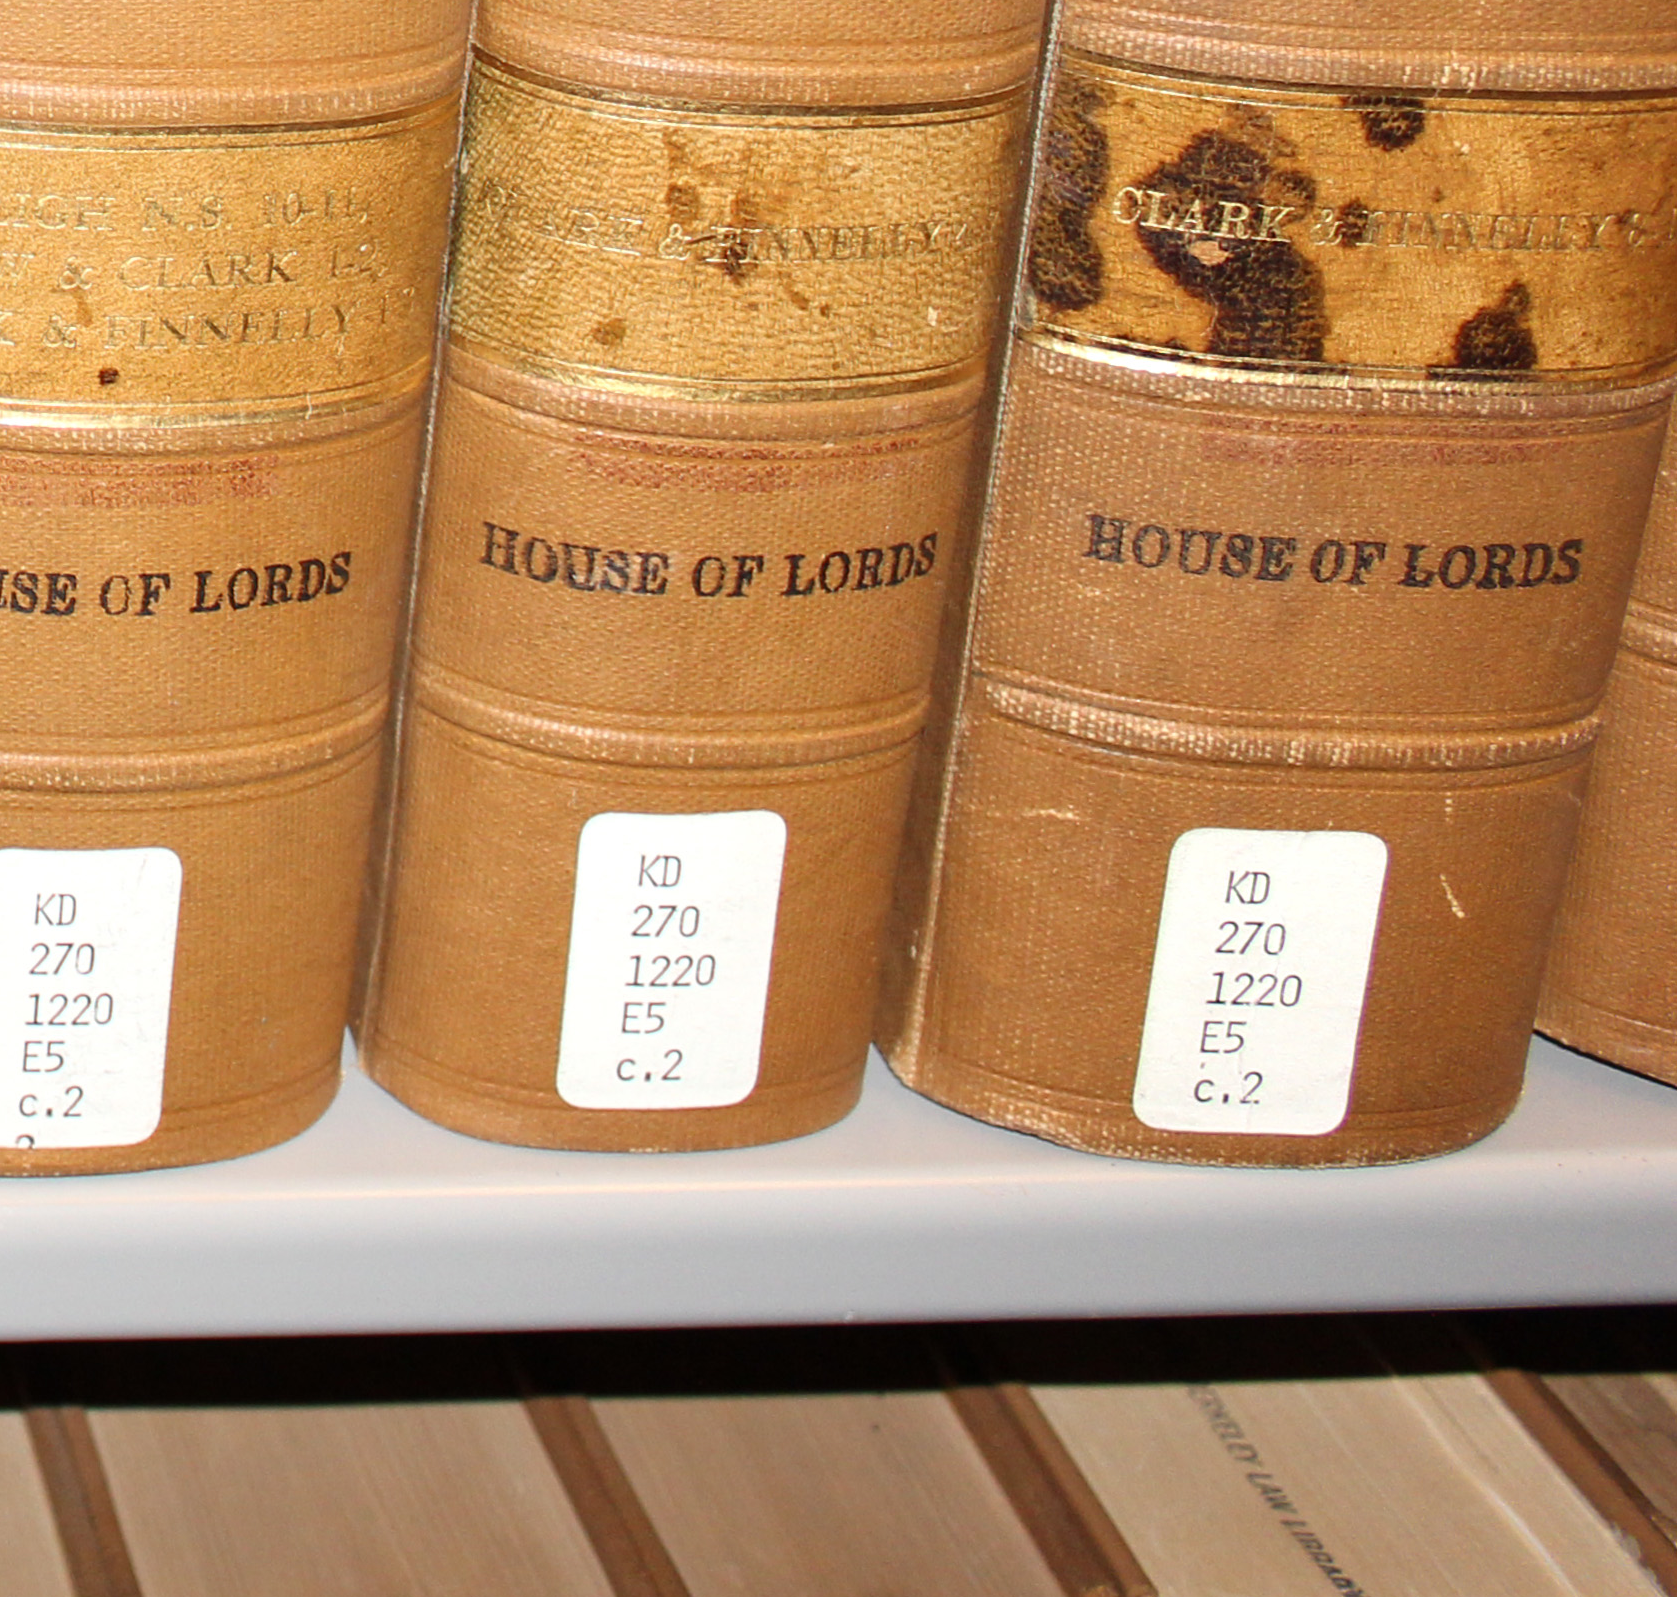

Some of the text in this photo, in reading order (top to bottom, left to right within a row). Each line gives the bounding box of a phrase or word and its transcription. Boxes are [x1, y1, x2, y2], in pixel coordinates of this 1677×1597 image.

[1112, 186, 1296, 245] CLARK
[57, 255, 94, 291] &
[117, 249, 298, 292] CLARK
[480, 520, 940, 601] HOUSE OF LORDS
[1082, 513, 1584, 591] HOUSE OF LORDS
[96, 572, 172, 618] OF
[188, 550, 353, 616] LORDS
[638, 854, 683, 888] KD
[1224, 870, 1271, 905] KD
[34, 893, 78, 926] KD
[630, 904, 701, 938] 270
[1214, 920, 1287, 956] 270
[28, 942, 96, 976] 270
[624, 954, 717, 988] 1220
[1205, 971, 1303, 1008] 1220
[24, 992, 115, 1026] 1220
[620, 1001, 667, 1034] E5
[1199, 1020, 1248, 1055] E5
[21, 1040, 66, 1073] E5
[615, 1048, 684, 1083] c.2
[18, 1085, 85, 1118] c.2
[1193, 1070, 1264, 1106] c.2
